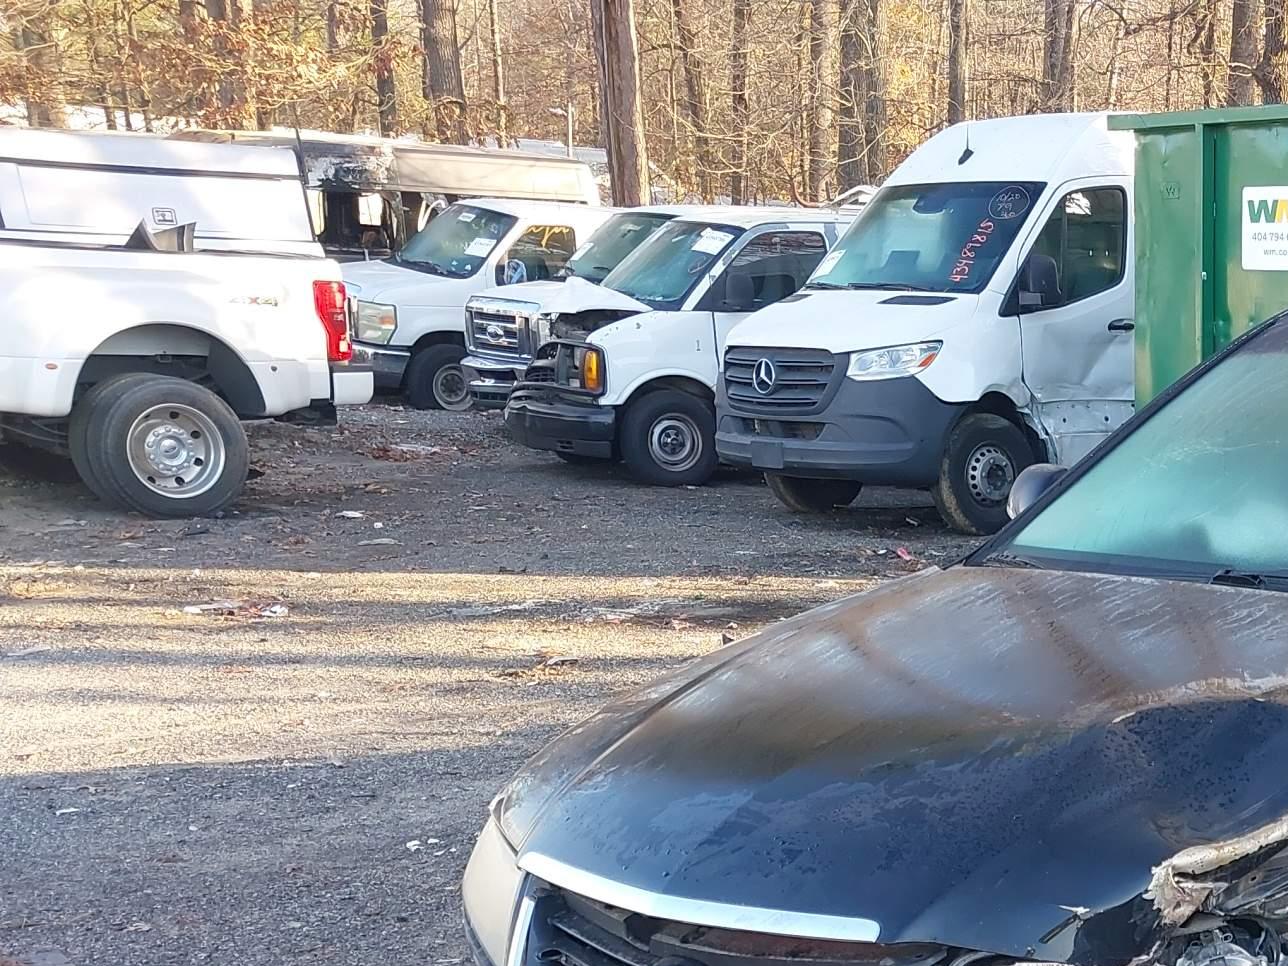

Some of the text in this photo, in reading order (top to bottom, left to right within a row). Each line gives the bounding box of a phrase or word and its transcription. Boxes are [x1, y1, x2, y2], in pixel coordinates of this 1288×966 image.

[948, 218, 994, 282] 43489815
[1251, 232, 1267, 241] 404
[1269, 232, 1284, 241] 794
